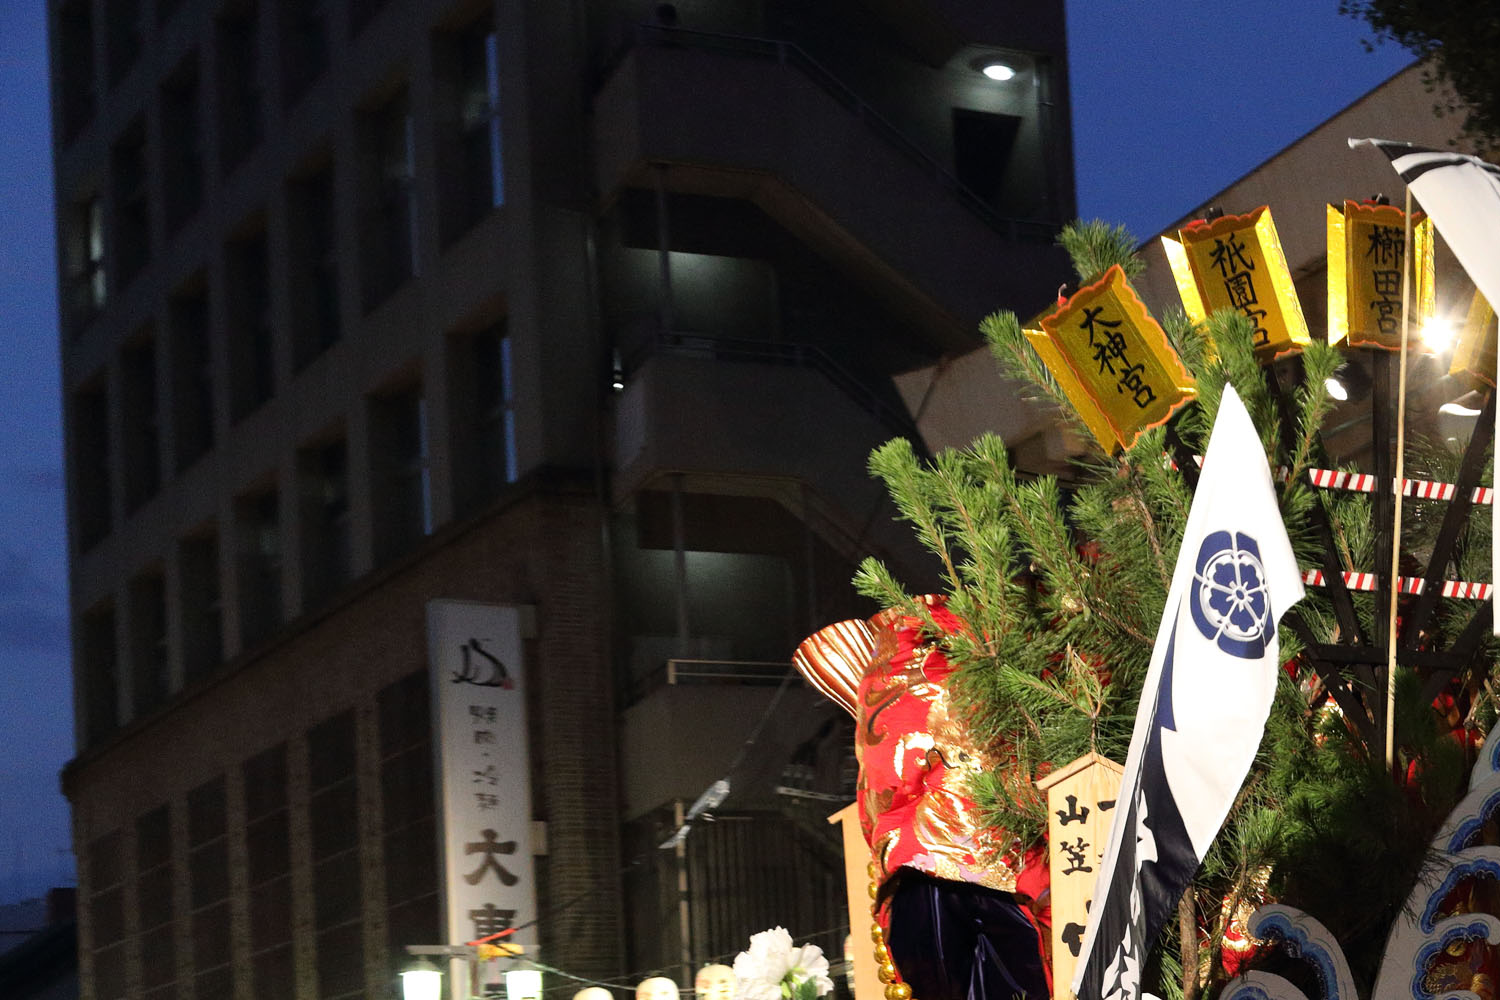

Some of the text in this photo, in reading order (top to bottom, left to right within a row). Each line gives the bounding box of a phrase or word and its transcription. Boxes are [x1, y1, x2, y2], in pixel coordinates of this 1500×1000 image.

[1366, 223, 1406, 335] 櫛田宮
[1079, 306, 1157, 409] 大神宮
[1055, 794, 1094, 876] 山笠
[462, 828, 521, 1000] 大東
